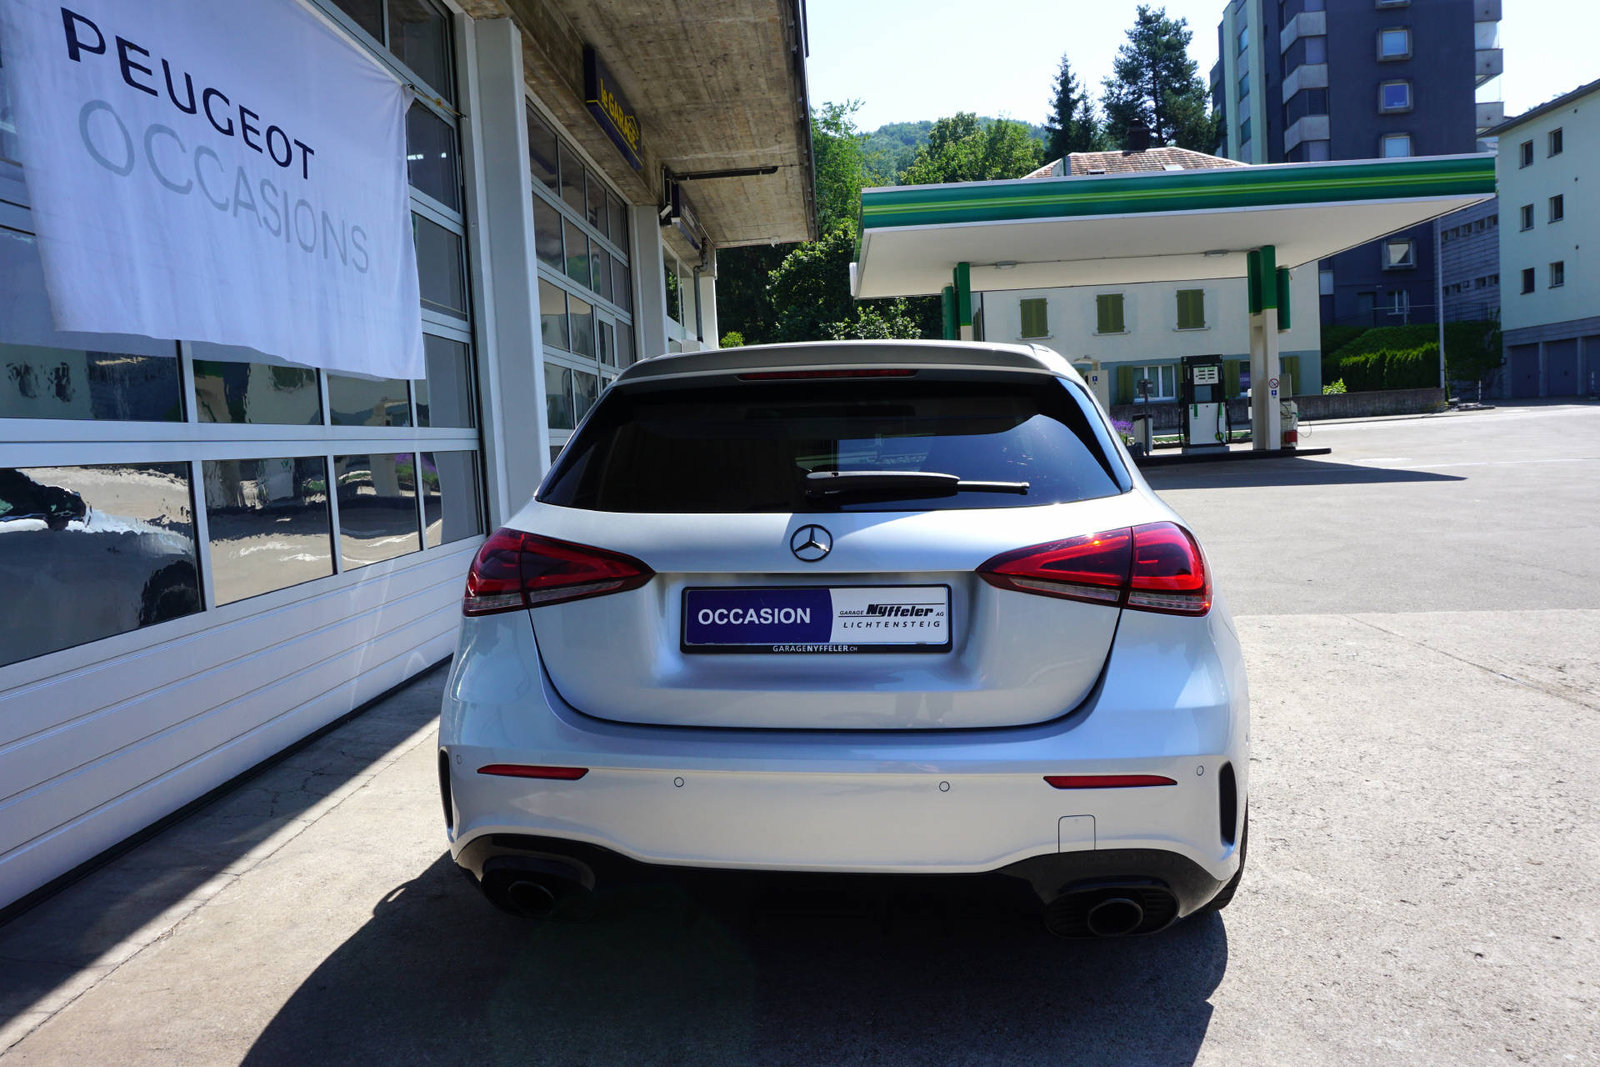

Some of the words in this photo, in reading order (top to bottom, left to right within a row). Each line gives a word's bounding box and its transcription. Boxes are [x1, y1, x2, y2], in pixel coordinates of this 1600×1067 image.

[61, 7, 314, 179] PEUGEOT
[608, 92, 638, 151] GARAGE
[79, 100, 369, 273] OCCASIONS
[698, 608, 811, 625] OCCASION
[866, 604, 933, 617] Nyffeler
